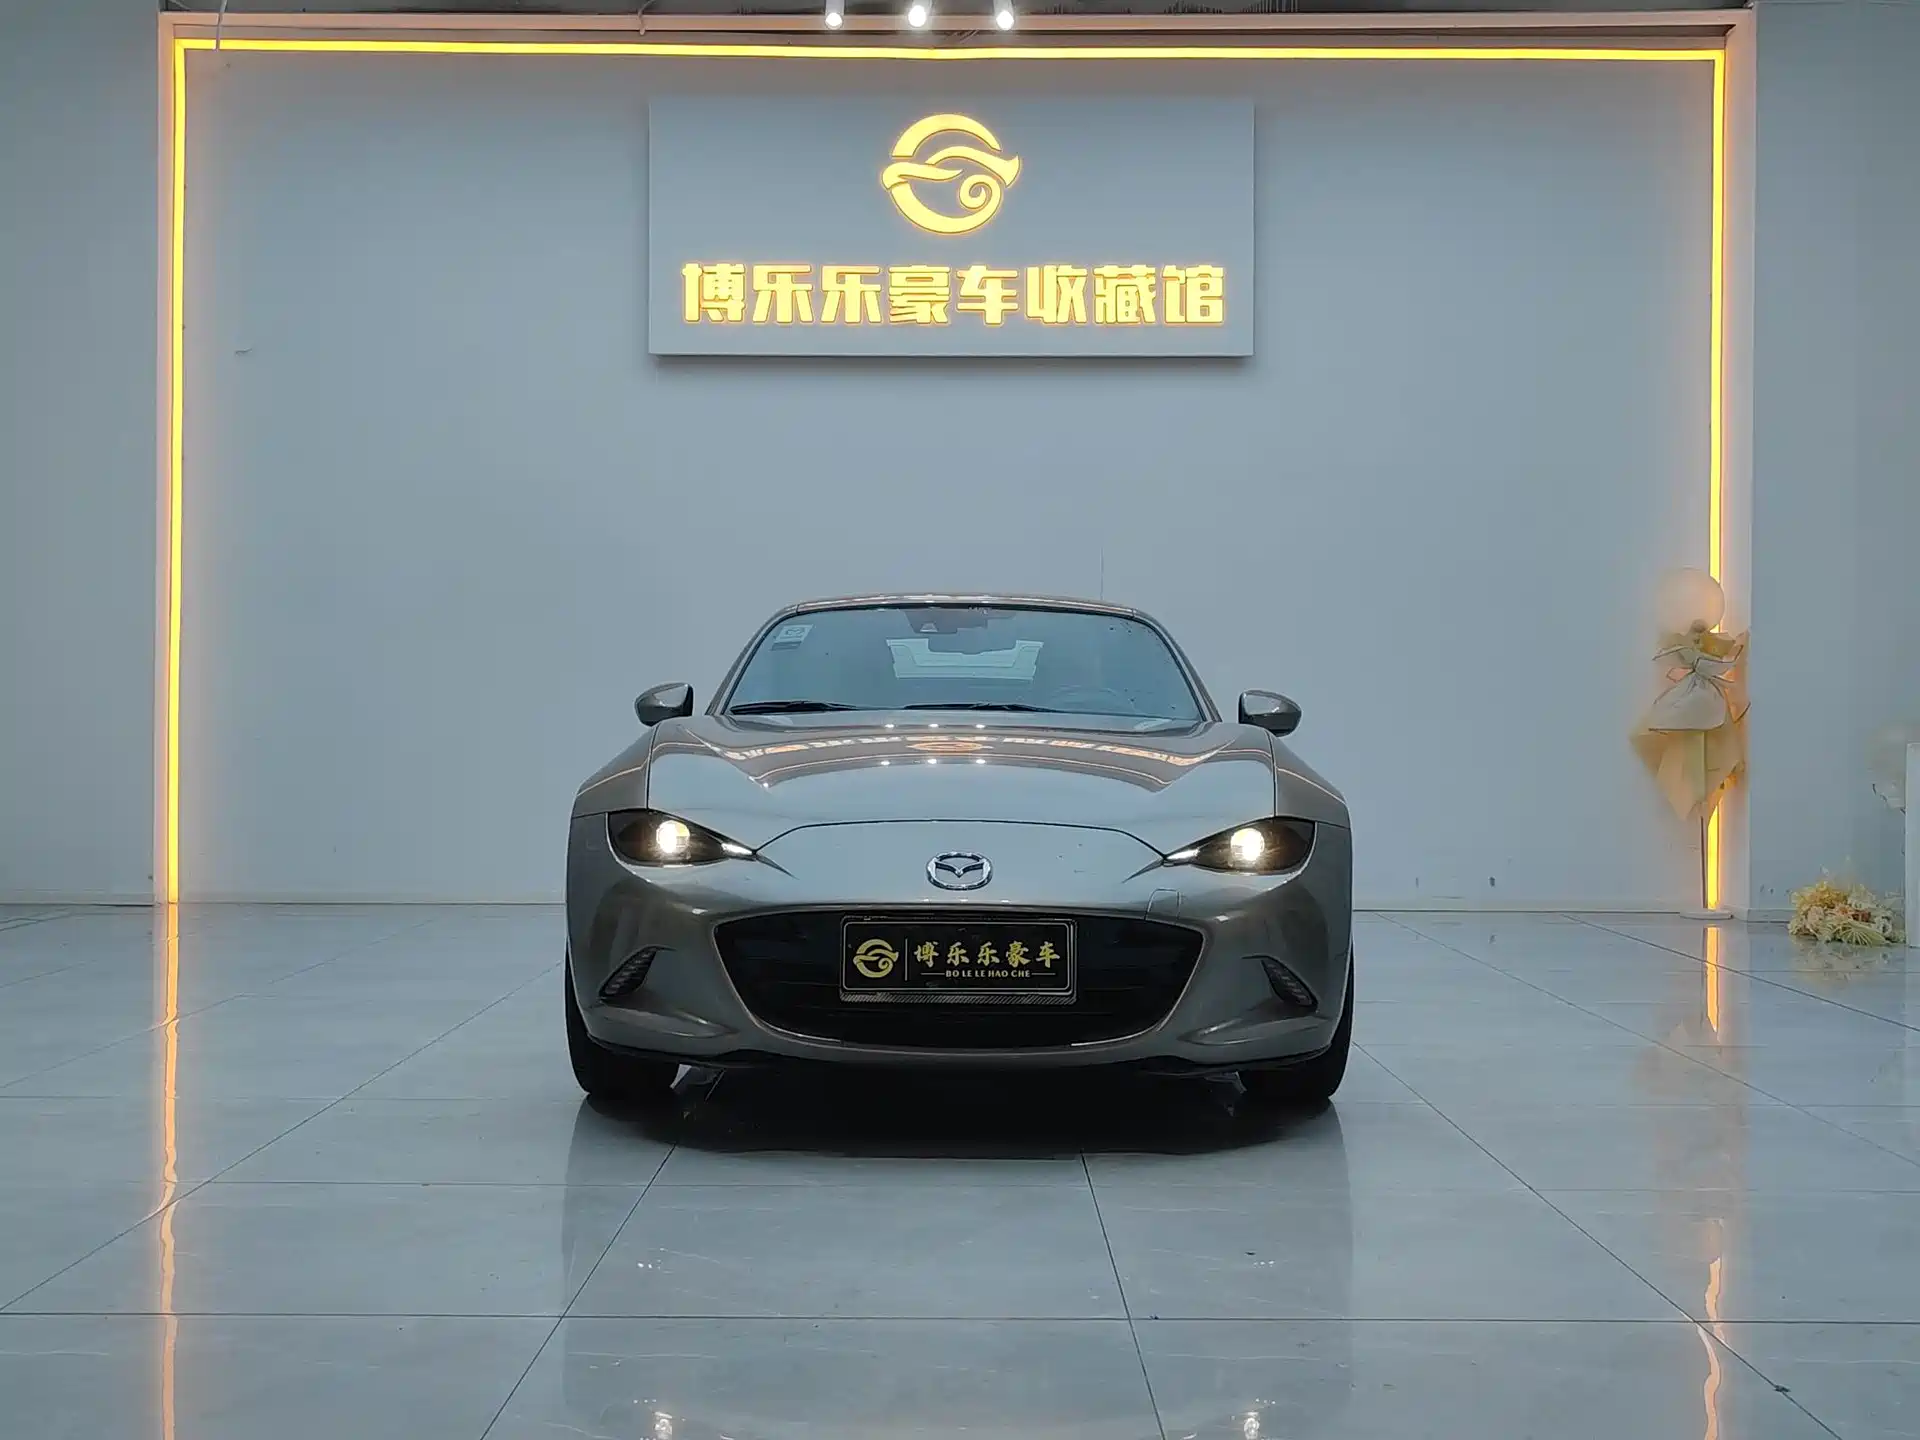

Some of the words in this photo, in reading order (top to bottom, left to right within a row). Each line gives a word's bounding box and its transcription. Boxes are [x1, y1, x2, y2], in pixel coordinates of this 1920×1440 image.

[682, 262, 1225, 324] 博乐乐豪车收藏馆
[914, 941, 1060, 968] 博乐乐豪车
[945, 969, 960, 978] BO
[962, 969, 973, 978] LE
[974, 969, 986, 978] LE
[988, 969, 1009, 978] HAO
[1010, 969, 1031, 978] CHE
